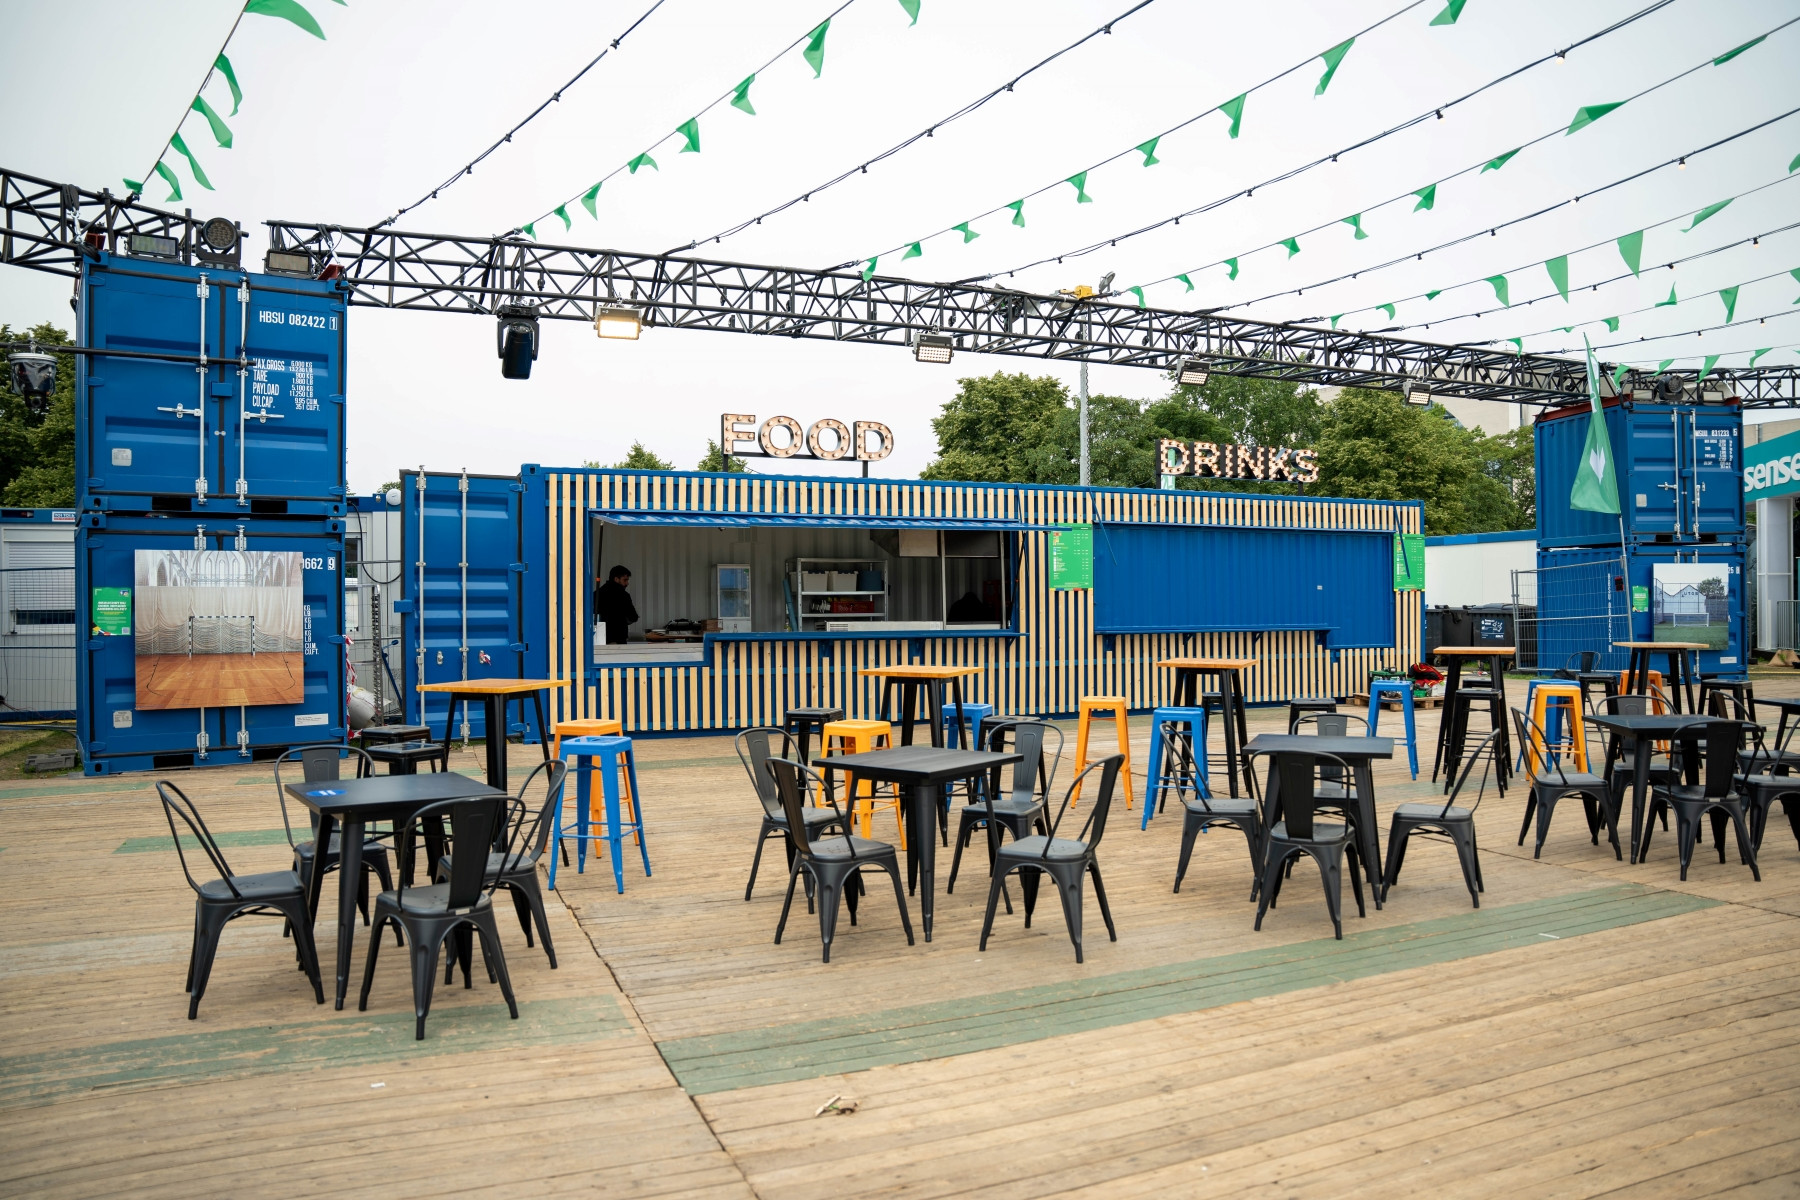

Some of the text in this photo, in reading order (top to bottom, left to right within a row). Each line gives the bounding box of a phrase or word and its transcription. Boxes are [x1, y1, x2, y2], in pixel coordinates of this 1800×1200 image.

[260, 311, 336, 330] HBSU 082422 1
[254, 370, 268, 382] TARE
[253, 382, 279, 395] PAYLOAD
[721, 413, 894, 461] FOOD
[1155, 438, 1319, 482] DRINKS
[1744, 453, 1800, 492] sense
[303, 557, 335, 570] 662 9
